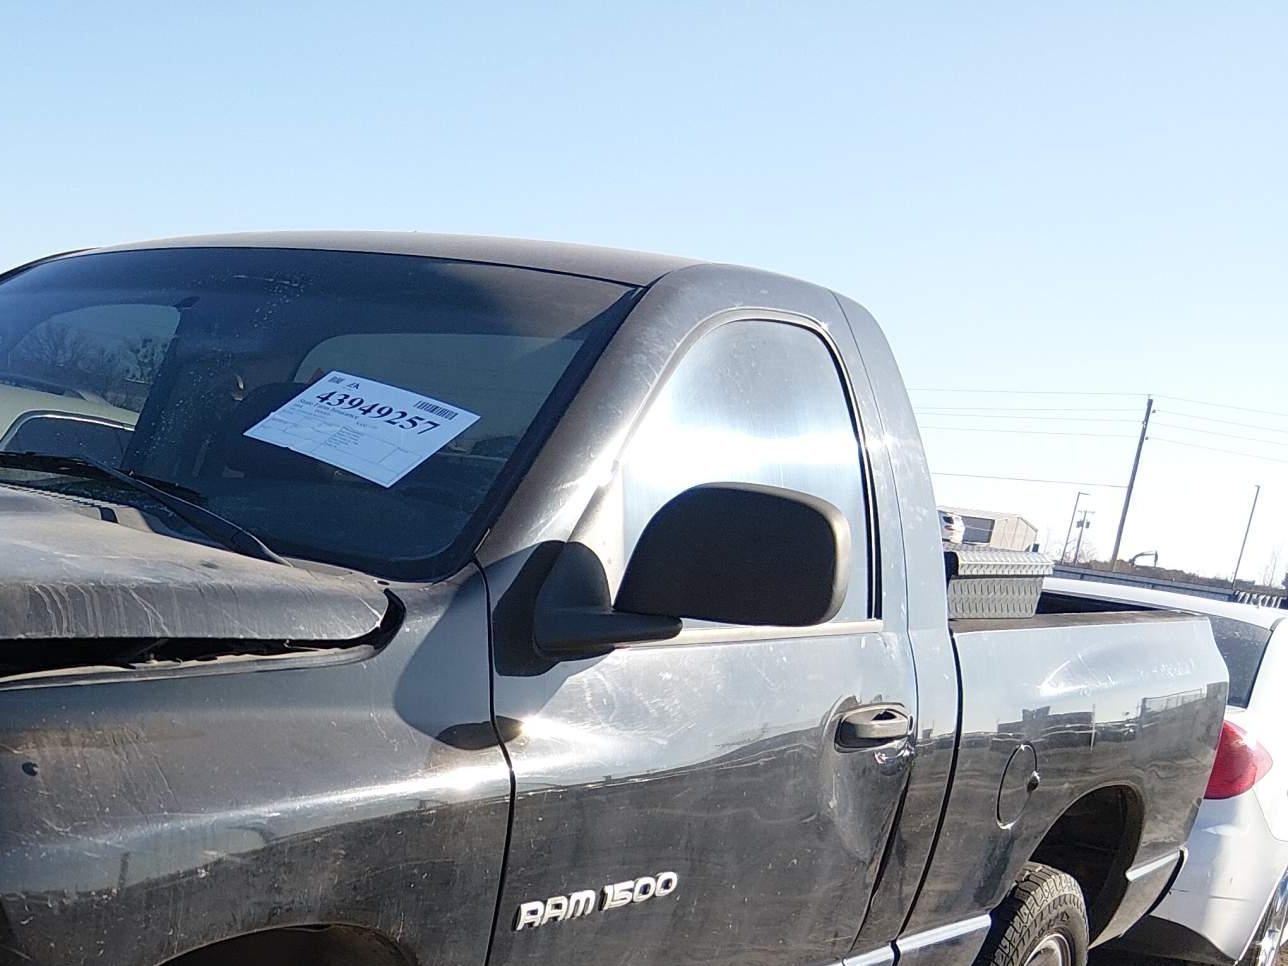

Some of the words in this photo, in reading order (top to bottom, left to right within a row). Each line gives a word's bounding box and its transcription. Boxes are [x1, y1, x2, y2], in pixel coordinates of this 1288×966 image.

[315, 391, 441, 435] 43949257
[512, 889, 596, 931] RAM
[599, 871, 678, 912] 1500
